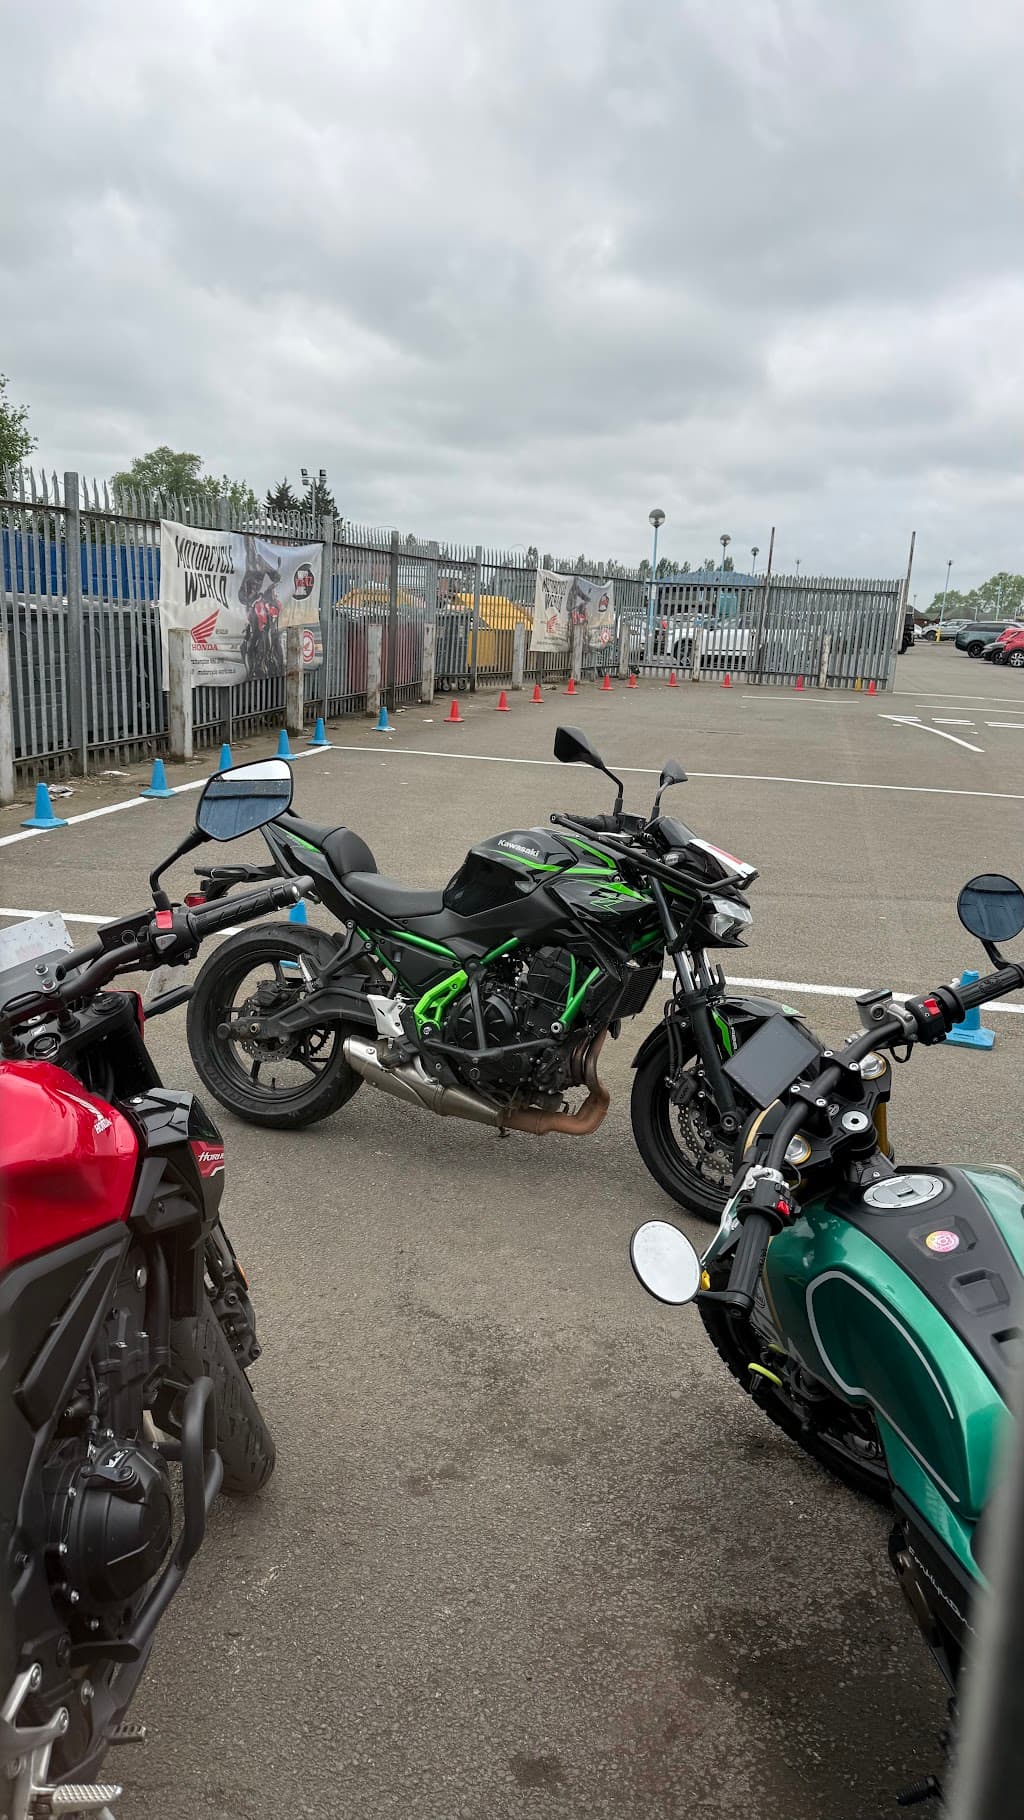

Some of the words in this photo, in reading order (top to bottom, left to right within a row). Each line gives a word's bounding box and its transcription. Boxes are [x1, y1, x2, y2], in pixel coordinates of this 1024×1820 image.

[175, 535, 235, 574] MOTORCYCLE
[185, 571, 229, 609] WORLD
[191, 643, 218, 651] HONDA
[497, 839, 540, 857] Kawasaki
